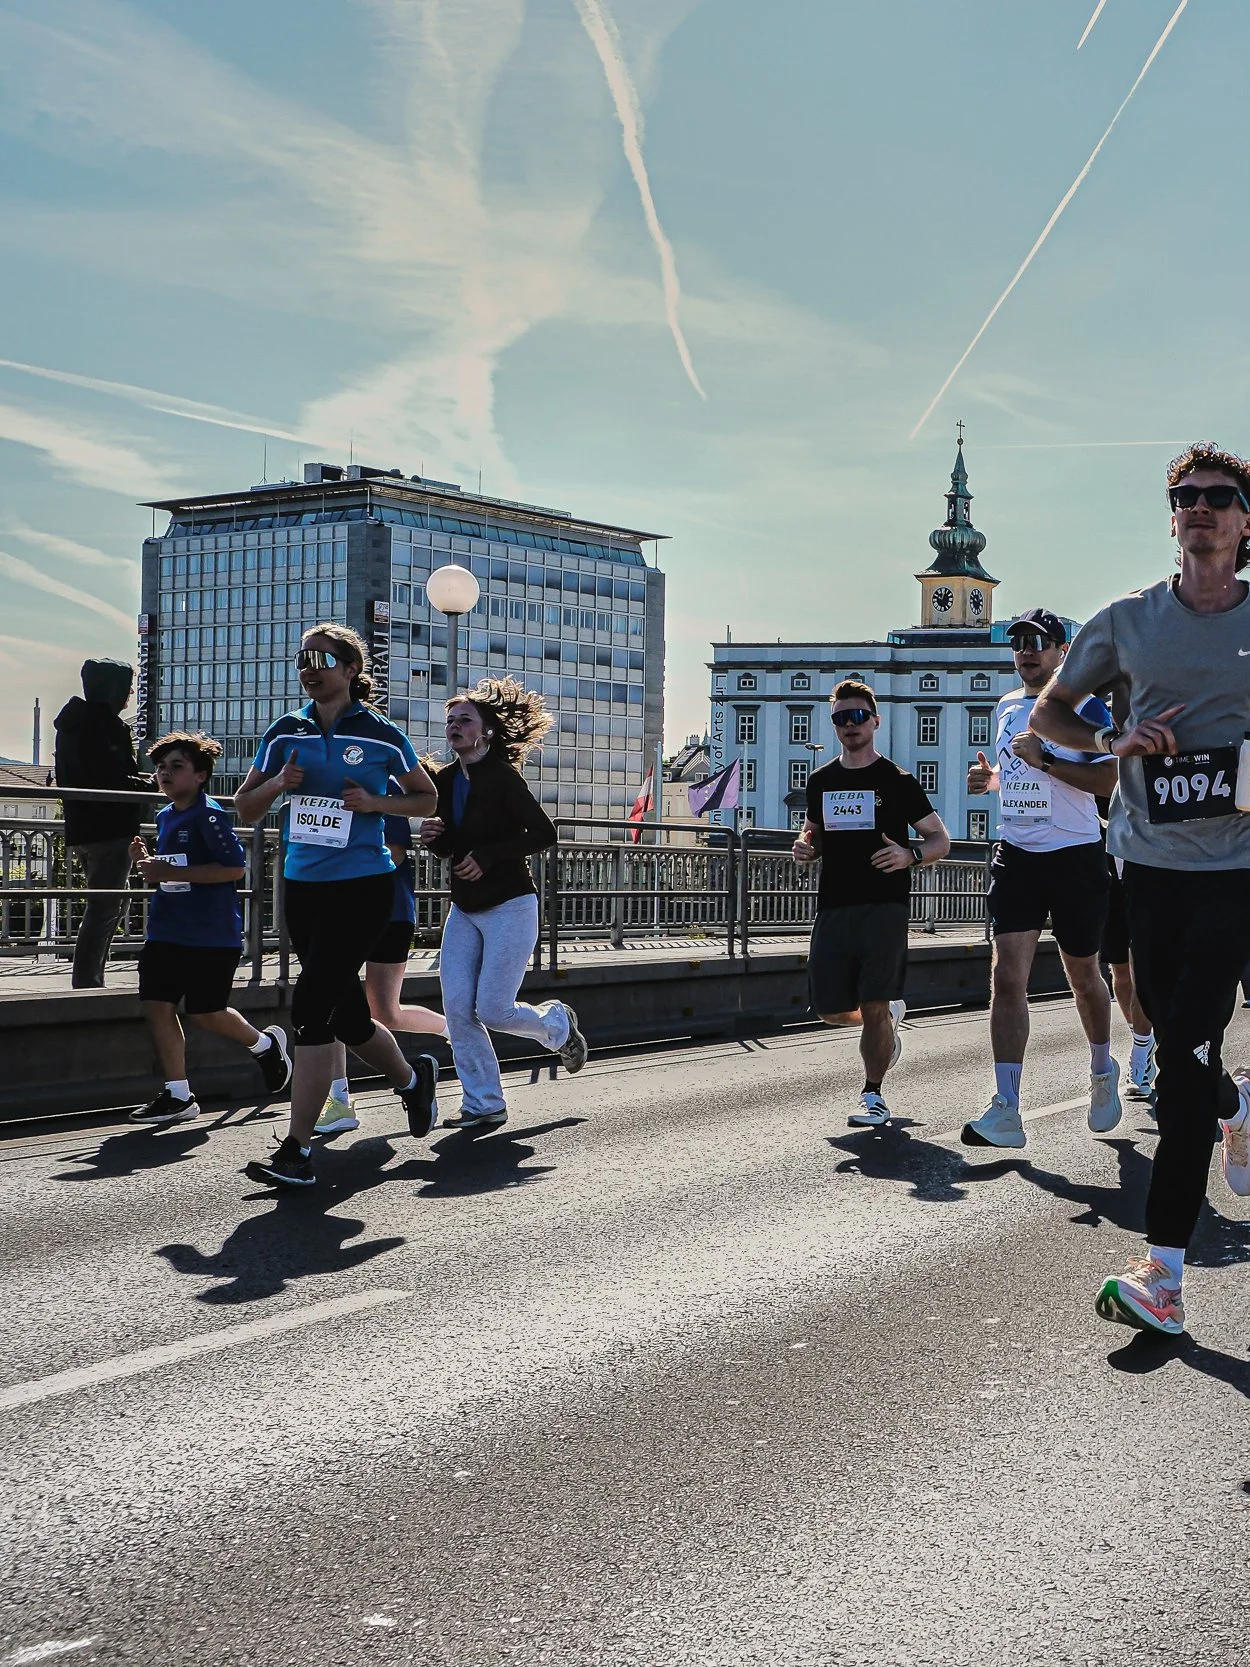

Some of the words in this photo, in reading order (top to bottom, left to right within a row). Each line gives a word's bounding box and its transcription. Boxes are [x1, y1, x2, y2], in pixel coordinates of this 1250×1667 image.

[372, 631, 389, 716] NERALI
[136, 641, 149, 741] GENERALI
[712, 712, 724, 742] Arts
[712, 745, 723, 759] of
[1006, 781, 1040, 791] KEBA
[1154, 770, 1231, 805] 9094
[300, 797, 340, 810] KEBA
[830, 792, 864, 801] KEBA
[833, 804, 862, 816] 2443
[1002, 799, 1048, 809] ALEXANDER
[296, 812, 343, 830] ISOLDE
